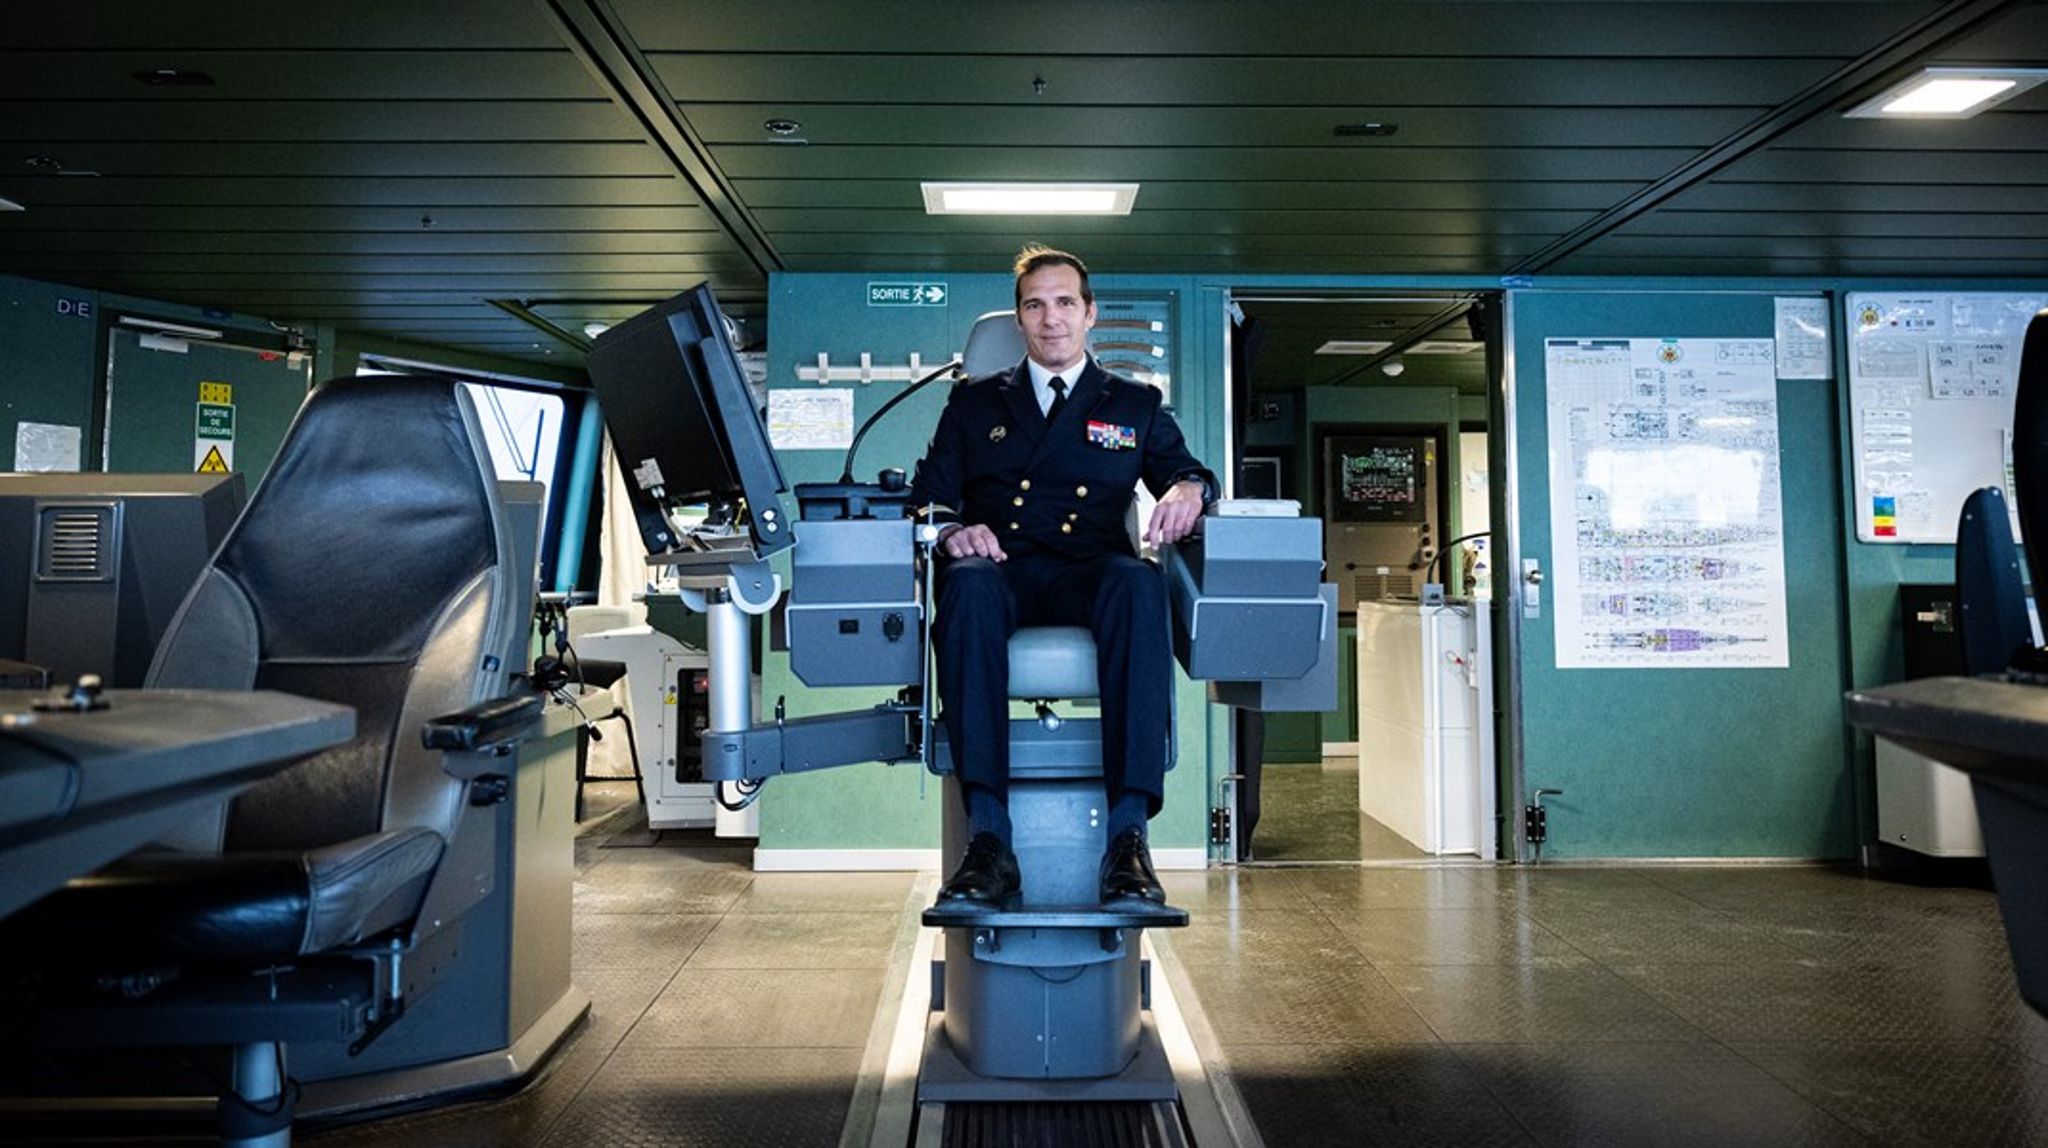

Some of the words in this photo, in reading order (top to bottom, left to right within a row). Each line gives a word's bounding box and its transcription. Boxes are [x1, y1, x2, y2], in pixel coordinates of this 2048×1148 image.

[872, 288, 910, 300] SORTIE
[203, 408, 229, 418] SORTIE
[210, 418, 221, 426] DE
[199, 426, 231, 436] SECOURS
